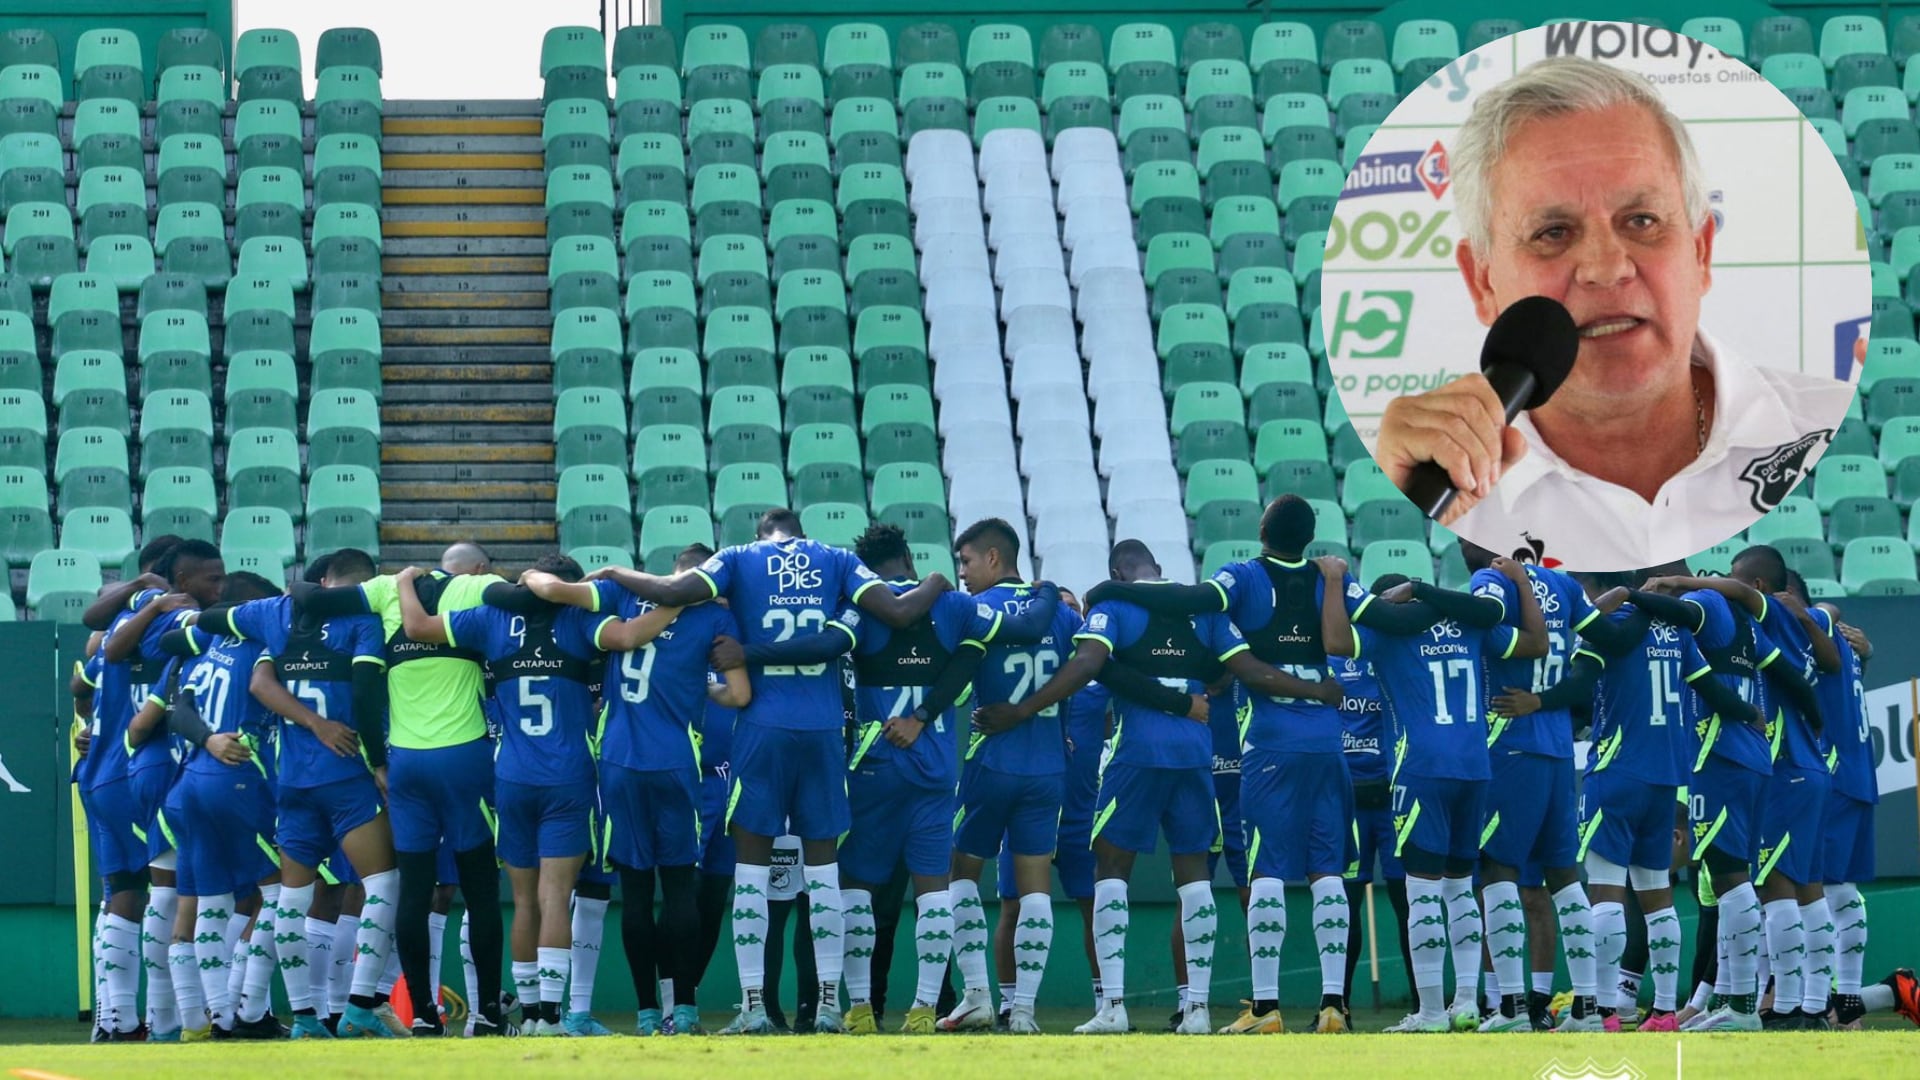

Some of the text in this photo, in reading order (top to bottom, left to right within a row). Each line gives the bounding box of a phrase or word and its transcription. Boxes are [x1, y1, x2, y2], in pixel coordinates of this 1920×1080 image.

[260, 35, 279, 44] 215
[567, 32, 584, 41] 217
[709, 32, 728, 41] 219
[850, 31, 868, 40] 221
[992, 31, 1011, 40] 223
[100, 36, 119, 45] 213
[21, 72, 40, 80] 210
[183, 72, 202, 81] 212
[341, 73, 359, 82] 214
[639, 72, 658, 81] 216
[783, 71, 801, 80] 218
[925, 71, 944, 79] 220
[99, 106, 118, 114] 209
[259, 106, 277, 115] 211
[568, 106, 587, 115] 213
[713, 106, 733, 115] 215
[856, 104, 874, 113] 217
[998, 104, 1017, 113] 219
[183, 141, 202, 150] 208
[339, 141, 359, 150] 210
[642, 141, 661, 150] 212
[788, 139, 806, 148] 214
[103, 174, 122, 183] 204
[262, 174, 281, 182] 206
[572, 172, 591, 181] 208
[718, 171, 737, 180] 210
[863, 170, 882, 179] 212
[32, 209, 50, 218] 201
[181, 209, 201, 218] 203
[339, 210, 359, 219] 205
[647, 208, 666, 216] 207
[795, 207, 815, 215] 209
[114, 243, 132, 251] 199
[264, 244, 282, 253] 201
[575, 243, 595, 252] 203
[726, 242, 745, 251] 205
[872, 242, 891, 251] 207
[78, 280, 97, 289] 195
[253, 280, 271, 289] 197
[652, 279, 672, 287] 200
[803, 277, 822, 286] 202
[167, 318, 185, 326] 193
[339, 316, 358, 325] 195
[578, 314, 597, 323] 196
[731, 313, 750, 322] 198
[882, 313, 902, 322] 200
[659, 356, 677, 364] 194
[809, 353, 828, 362] 196
[83, 358, 101, 367] 189
[255, 358, 272, 367] 191
[2, 396, 21, 405] 186
[337, 396, 356, 405] 190
[583, 395, 601, 404] 191
[736, 394, 755, 403] 193
[890, 392, 909, 401] 195
[170, 397, 189, 406] 188
[84, 435, 103, 444] 185
[256, 435, 274, 444] 187
[662, 433, 681, 441] 190
[815, 431, 834, 440] 192
[1760, 438, 1818, 477] DEPORTIVO
[336, 473, 356, 482] 185
[585, 473, 605, 482] 186
[741, 471, 761, 481] 188
[900, 470, 919, 479] 190
[6, 475, 24, 484] 181
[172, 475, 191, 484] 183
[90, 515, 110, 524] 180
[252, 515, 271, 524] 182
[670, 515, 689, 524] 185
[826, 511, 845, 520] 187
[56, 558, 76, 568] 175
[240, 557, 259, 567] 177
[589, 554, 609, 564] 179
[766, 552, 811, 576] DEO
[768, 594, 824, 607] Recamier
[1278, 634, 1312, 643] CATAPULT
[392, 642, 440, 653] CATAPULT
[1420, 643, 1469, 657] Recamier
[1151, 648, 1186, 657] CATAPULT
[512, 659, 564, 670] CATAPULT
[897, 656, 931, 666] CATAPULT
[283, 661, 330, 672] CATAPULT
[620, 641, 657, 704] 9
[1428, 658, 1477, 725] 17
[1647, 660, 1684, 728] 14
[518, 675, 554, 737] 5
